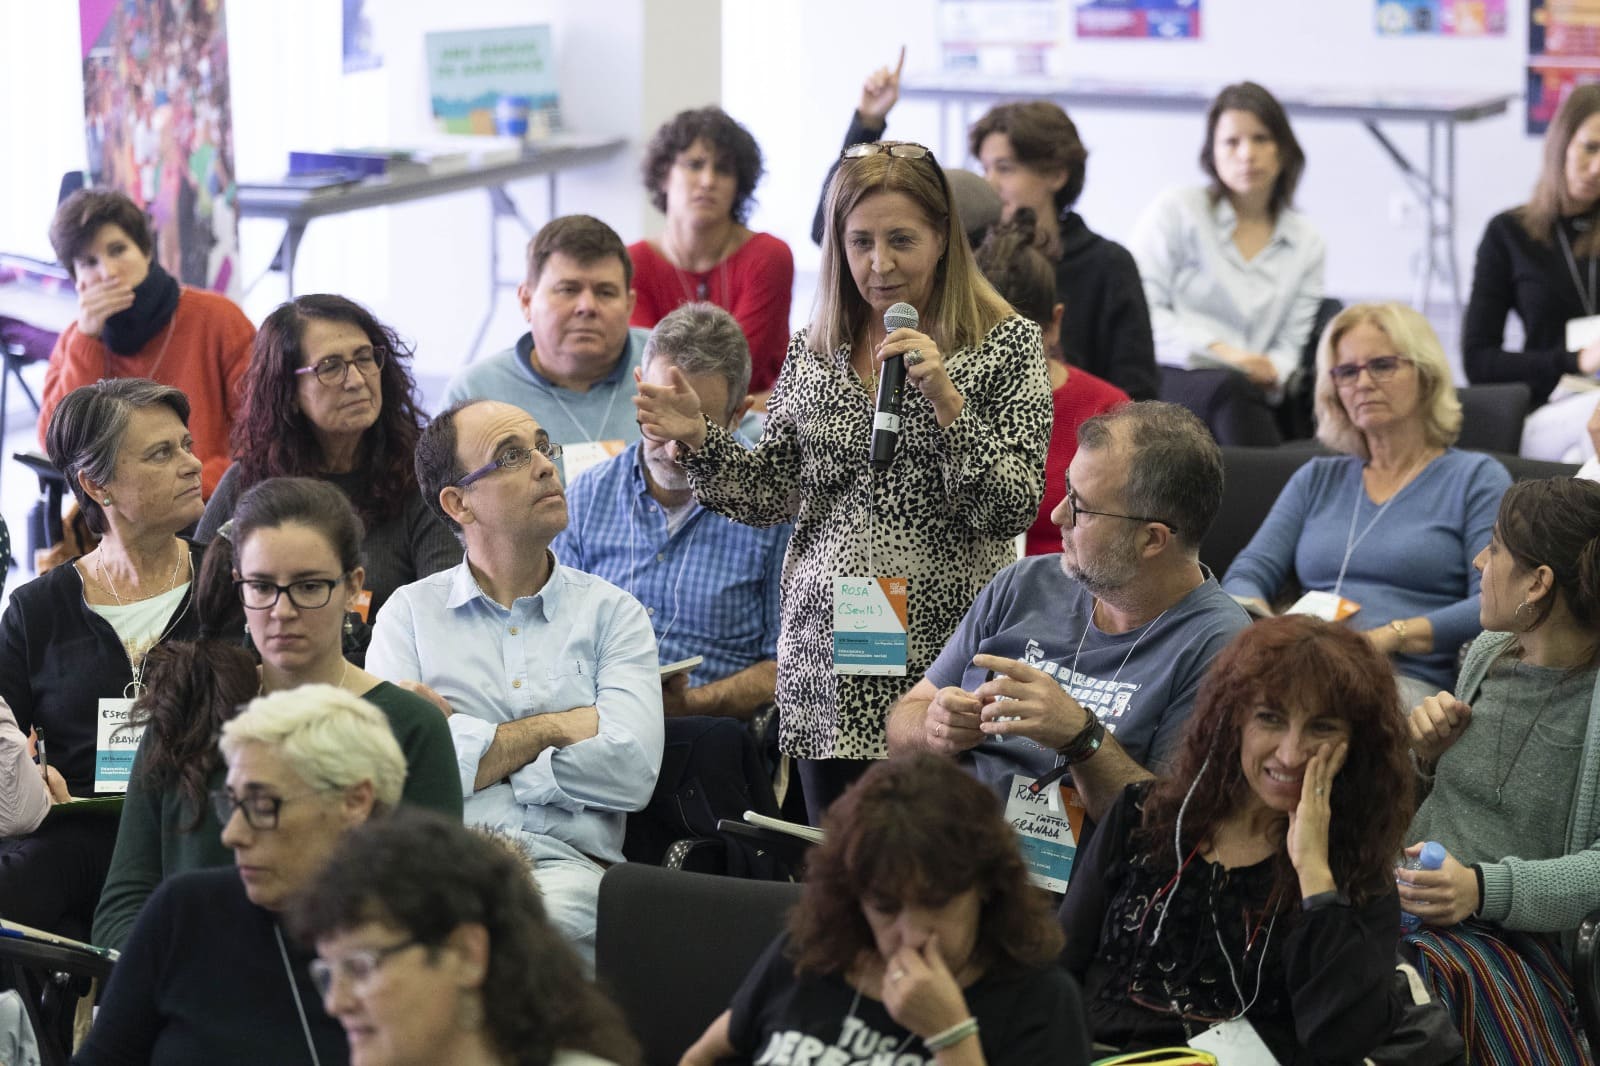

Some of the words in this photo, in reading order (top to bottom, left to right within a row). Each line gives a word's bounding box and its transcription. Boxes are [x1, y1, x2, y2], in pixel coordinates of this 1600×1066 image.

[887, 416, 893, 429] 1
[841, 584, 869, 597] ROSA
[102, 709, 128, 720] ESPE
[109, 735, 143, 745] GRANA
[1012, 818, 1060, 840] GRANADA
